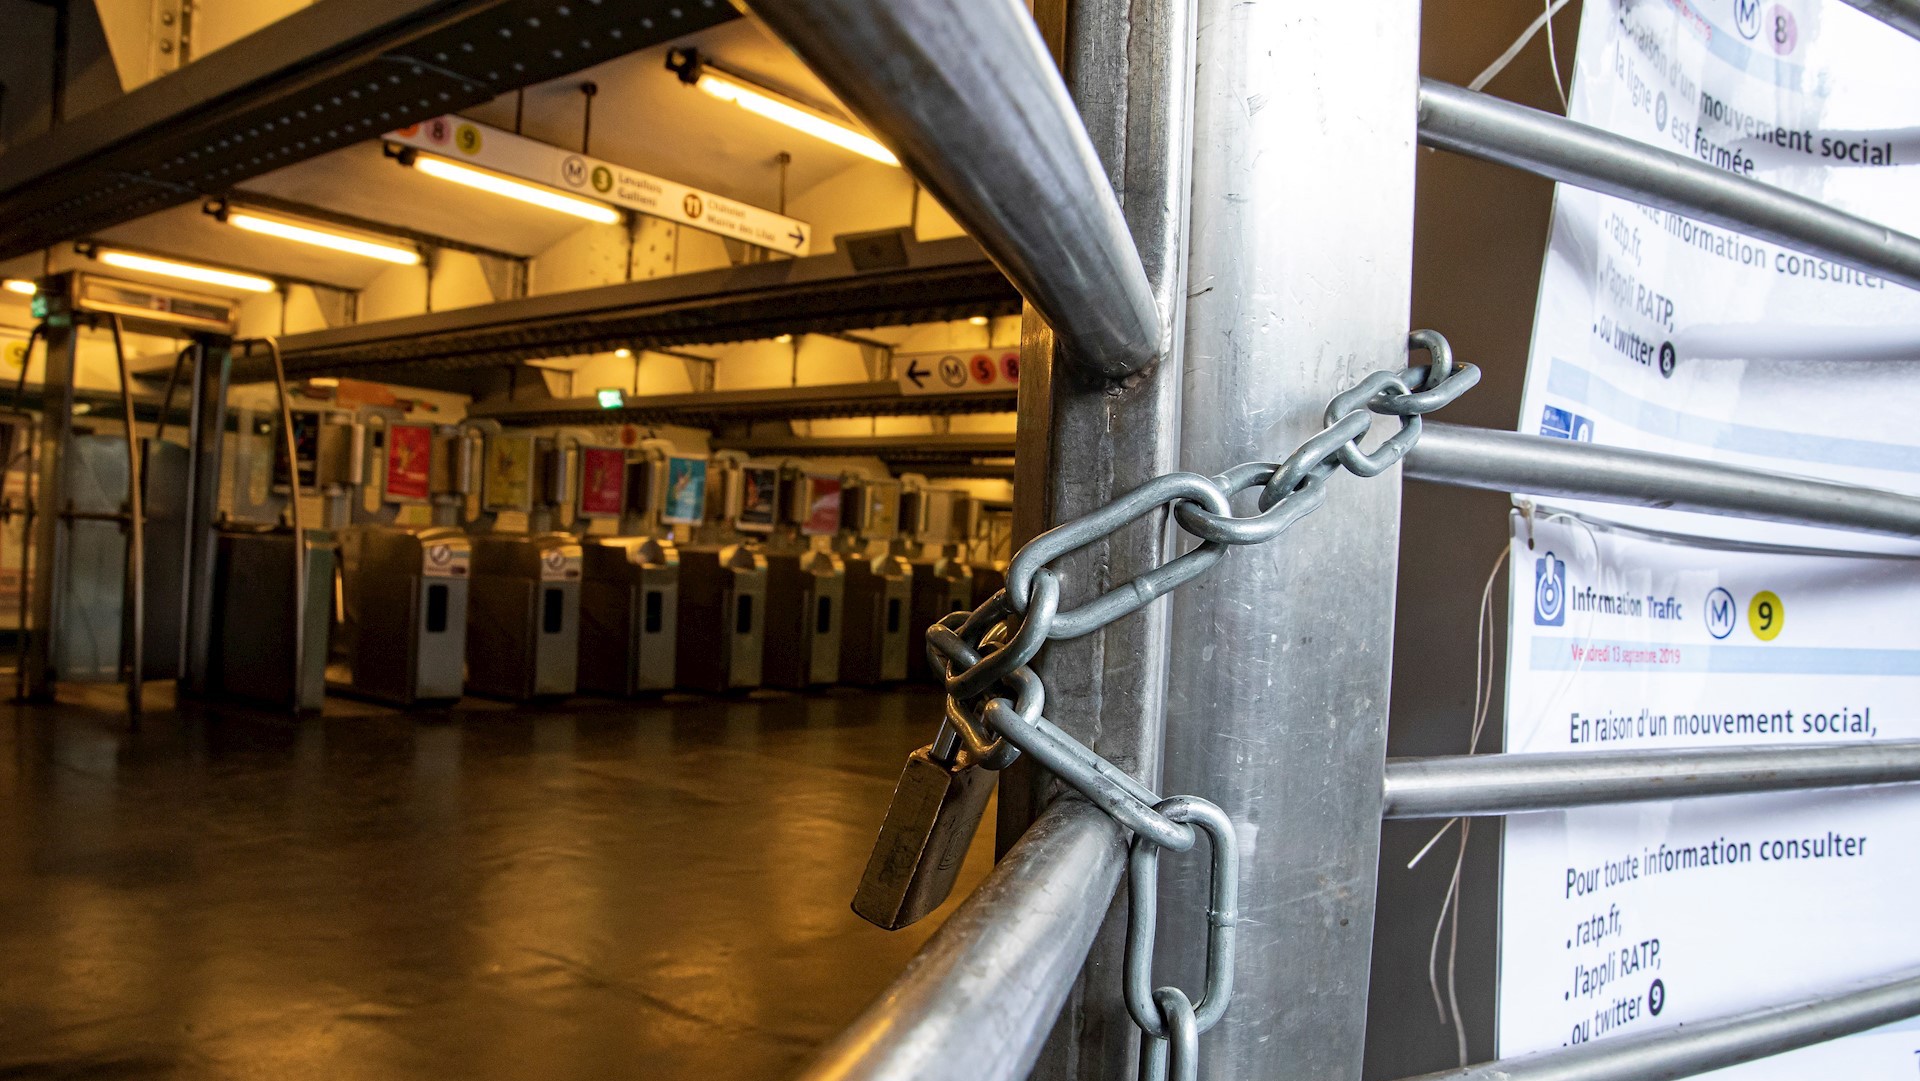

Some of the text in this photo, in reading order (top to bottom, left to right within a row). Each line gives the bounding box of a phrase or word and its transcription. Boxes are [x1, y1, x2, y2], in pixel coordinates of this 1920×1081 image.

[1774, 15, 1788, 44] 8
[1615, 39, 1625, 81] la
[1626, 56, 1652, 114] ligne
[1671, 116, 1690, 149] est
[1700, 90, 1813, 153] mouvement
[1821, 137, 1899, 166] social
[1611, 211, 1642, 267] ratp.fr,
[1637, 283, 1674, 334] RATP,
[1600, 315, 1614, 344] ou
[1614, 320, 1655, 367] twitter
[1572, 585, 1642, 617] Information
[1646, 595, 1682, 621] Trafic
[1757, 601, 1774, 631] 9
[1658, 646, 1681, 664] 2019
[1570, 706, 1877, 743] En raison d'un mouvement social,
[1566, 831, 1867, 899] Pour toute information consulter
[1576, 903, 1622, 947] ratp.fr,
[1574, 938, 1661, 999] l'appli RATP,
[1572, 1019, 1589, 1046] ou
[1595, 995, 1643, 1037] twitter
